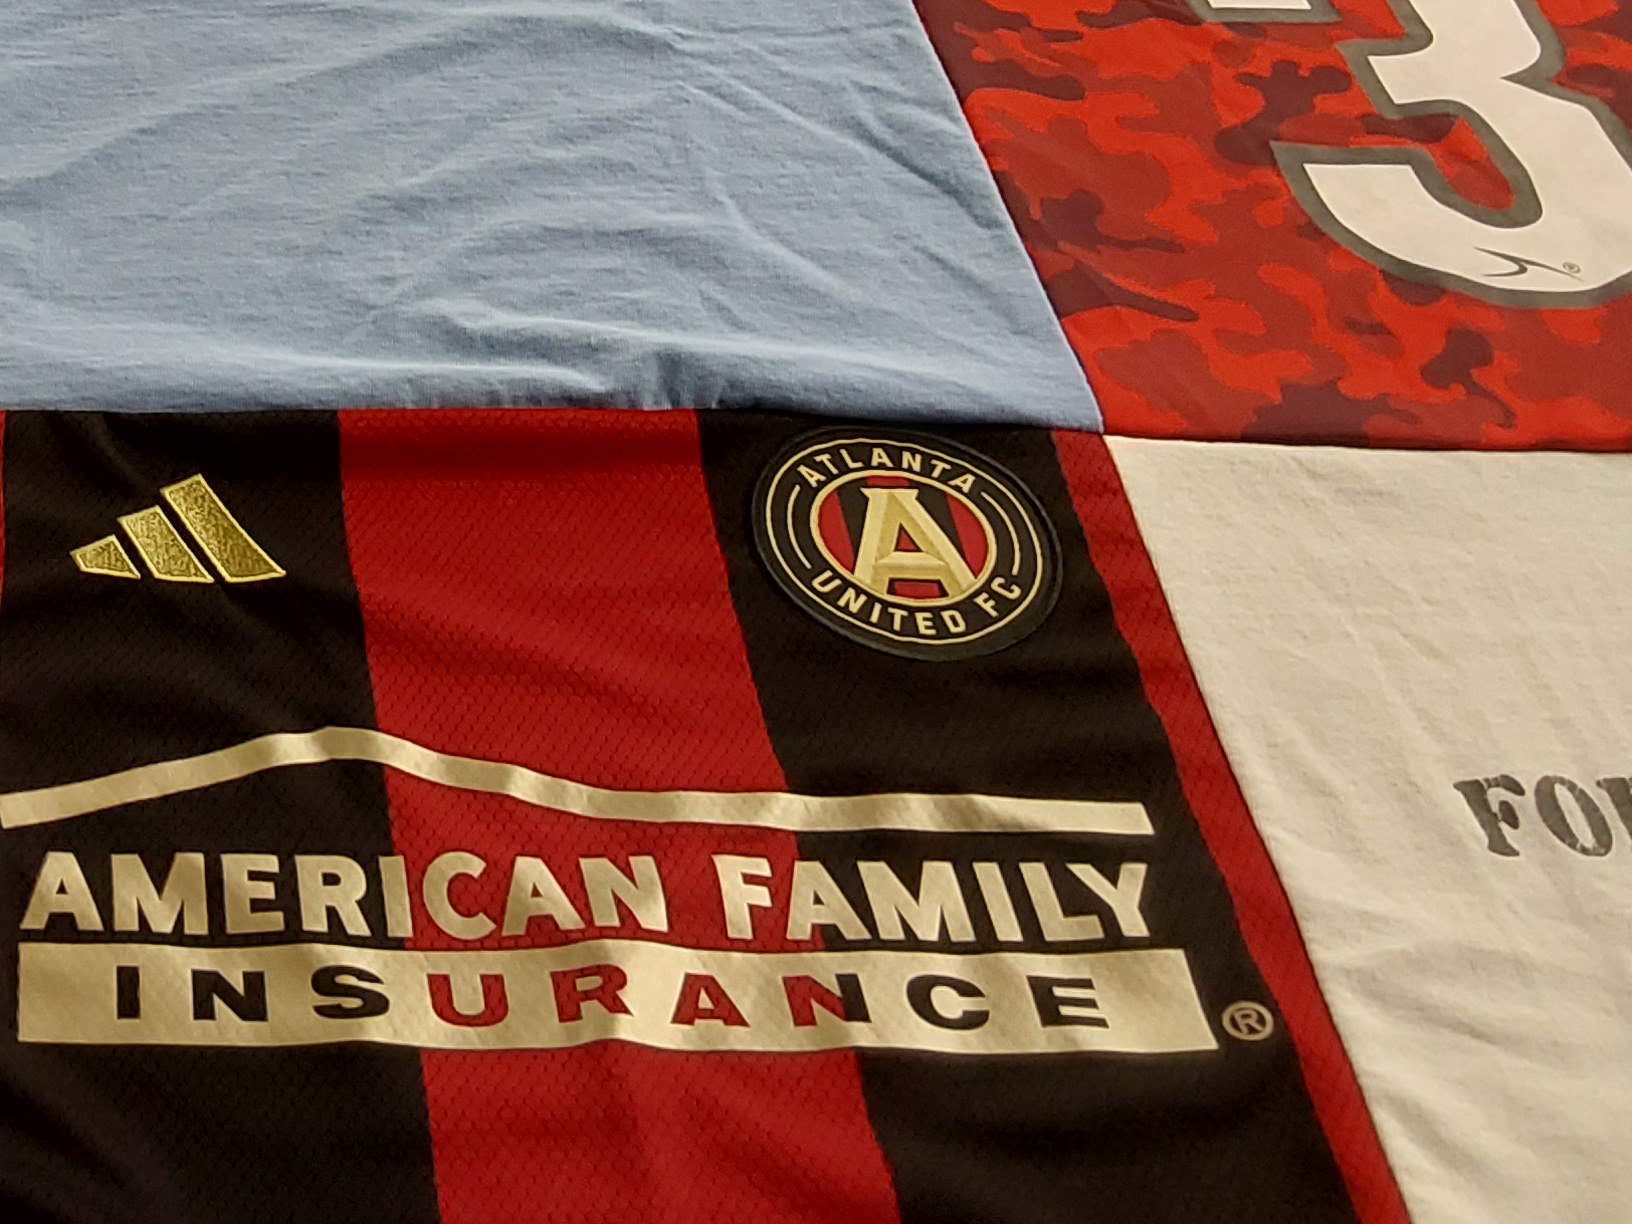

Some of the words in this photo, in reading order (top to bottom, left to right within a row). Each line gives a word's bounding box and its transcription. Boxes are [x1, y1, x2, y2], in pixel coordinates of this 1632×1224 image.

[796, 447, 977, 494] ATLANTA
[810, 569, 967, 636] UNITED
[972, 575, 1022, 618] FC
[20, 849, 669, 939] AMERICAN
[713, 851, 1152, 944] FAMILY
[114, 962, 1111, 1032] INSURANCE
